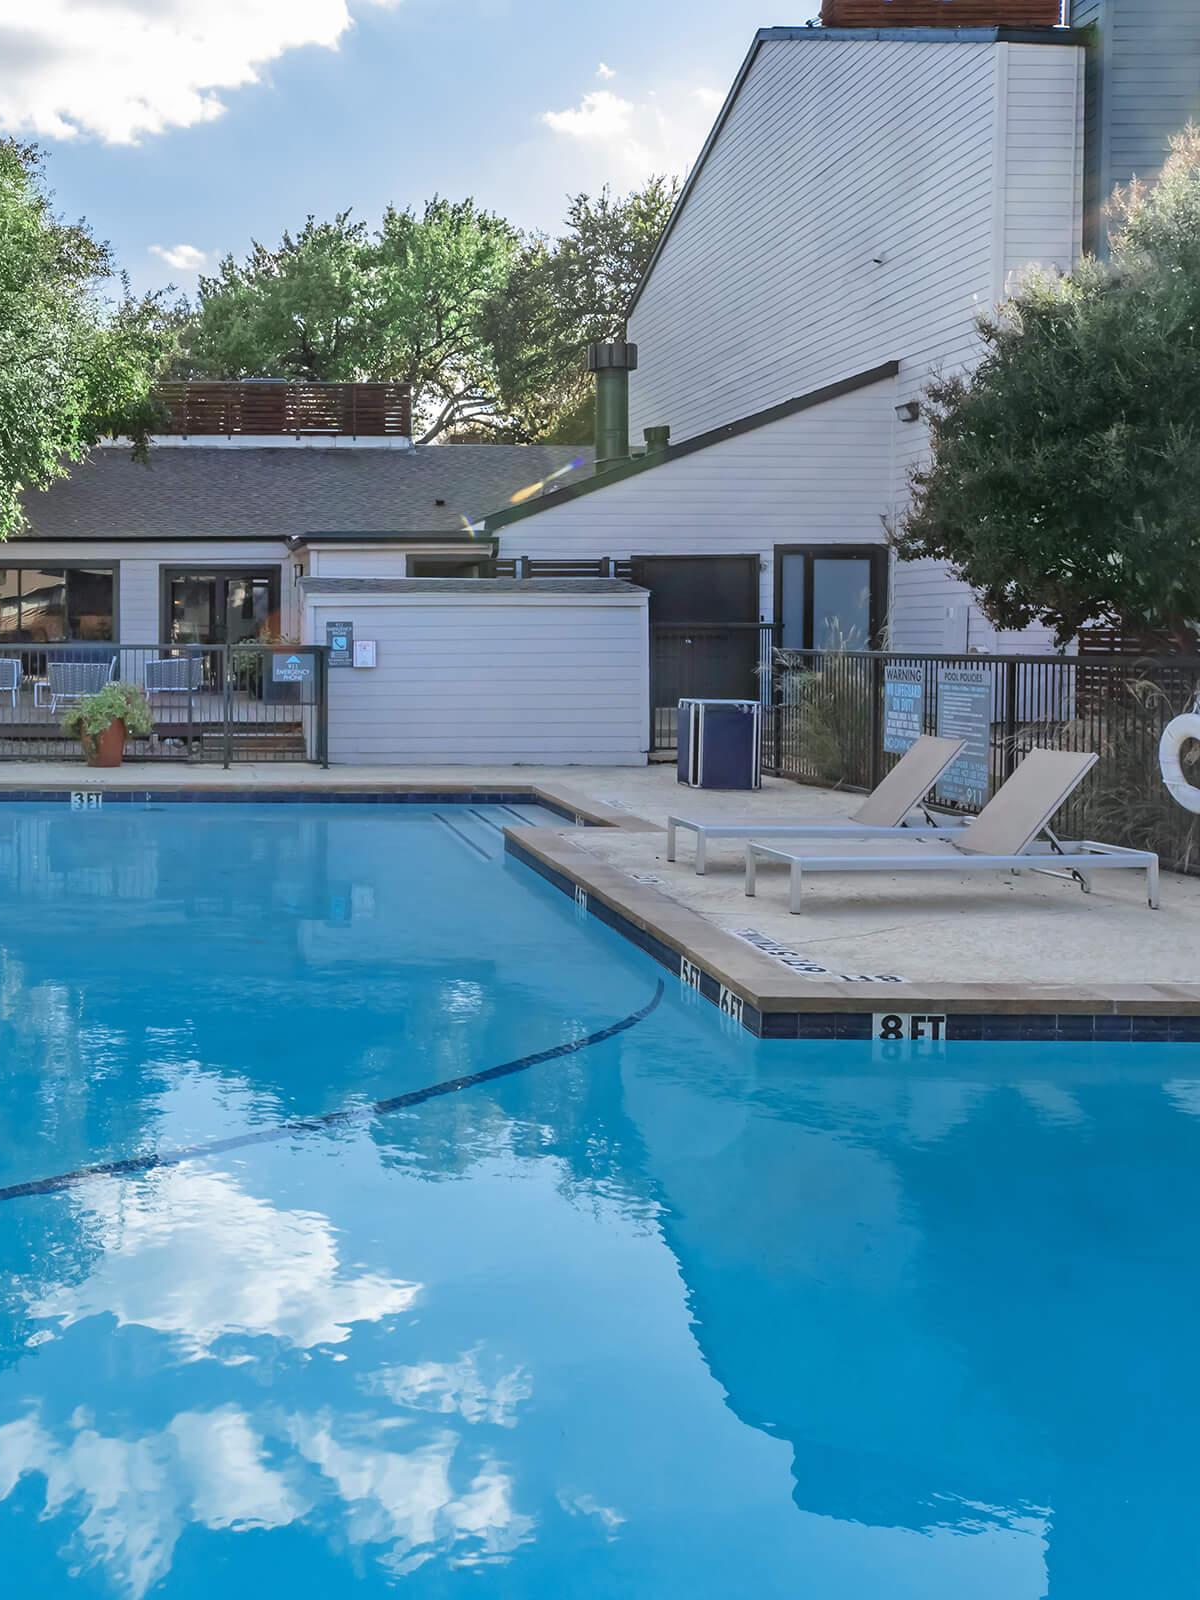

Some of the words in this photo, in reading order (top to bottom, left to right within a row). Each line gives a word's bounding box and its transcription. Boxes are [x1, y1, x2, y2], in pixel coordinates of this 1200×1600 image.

[886, 668, 922, 682] WARNING
[967, 787, 982, 804] 911
[880, 1014, 904, 1040] 8
[911, 1015, 945, 1041] FT
